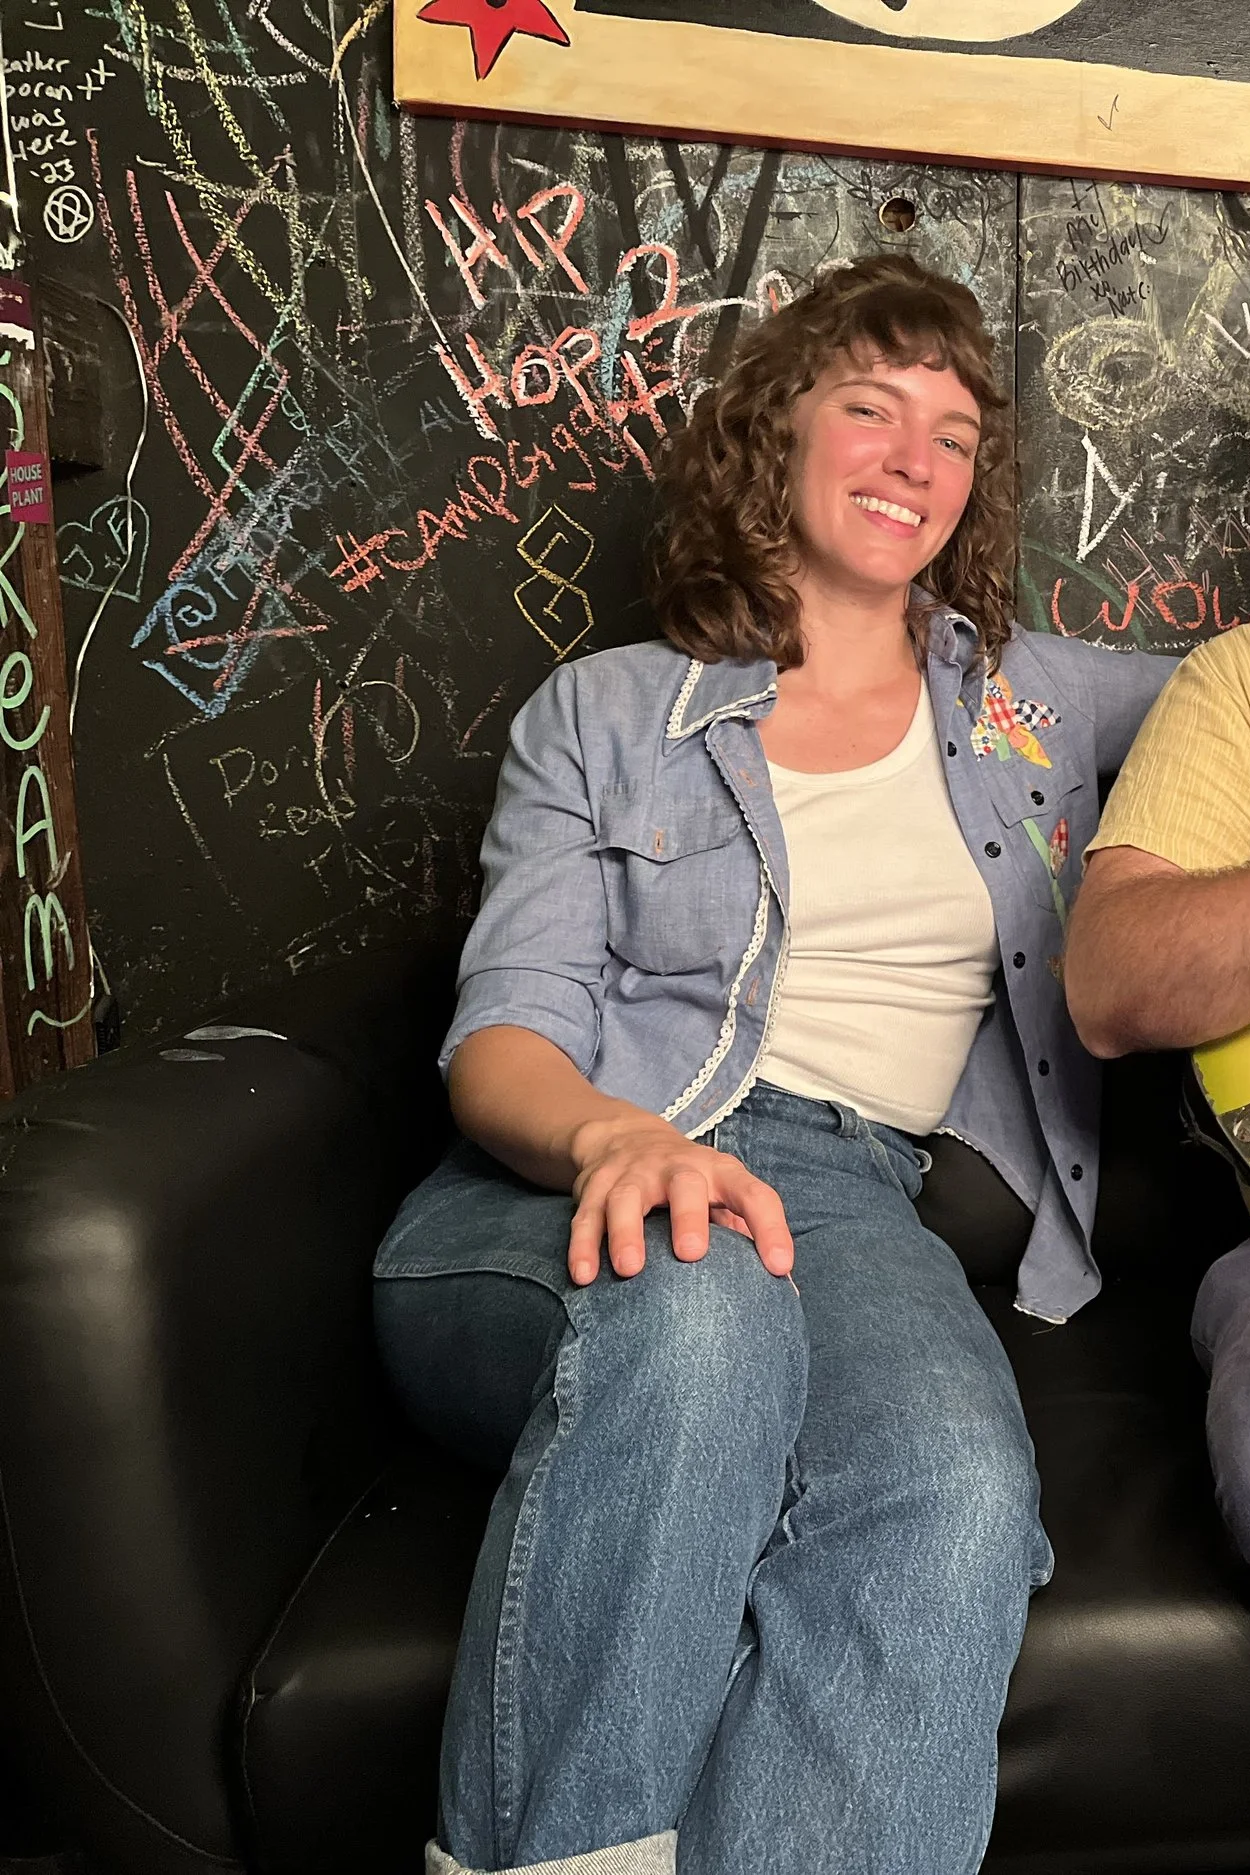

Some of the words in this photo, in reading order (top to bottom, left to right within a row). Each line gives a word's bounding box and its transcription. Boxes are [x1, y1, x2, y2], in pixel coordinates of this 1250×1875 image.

[11, 108, 66, 132] was
[10, 464, 43, 484] HOUSE
[11, 487, 44, 507] PLANT
